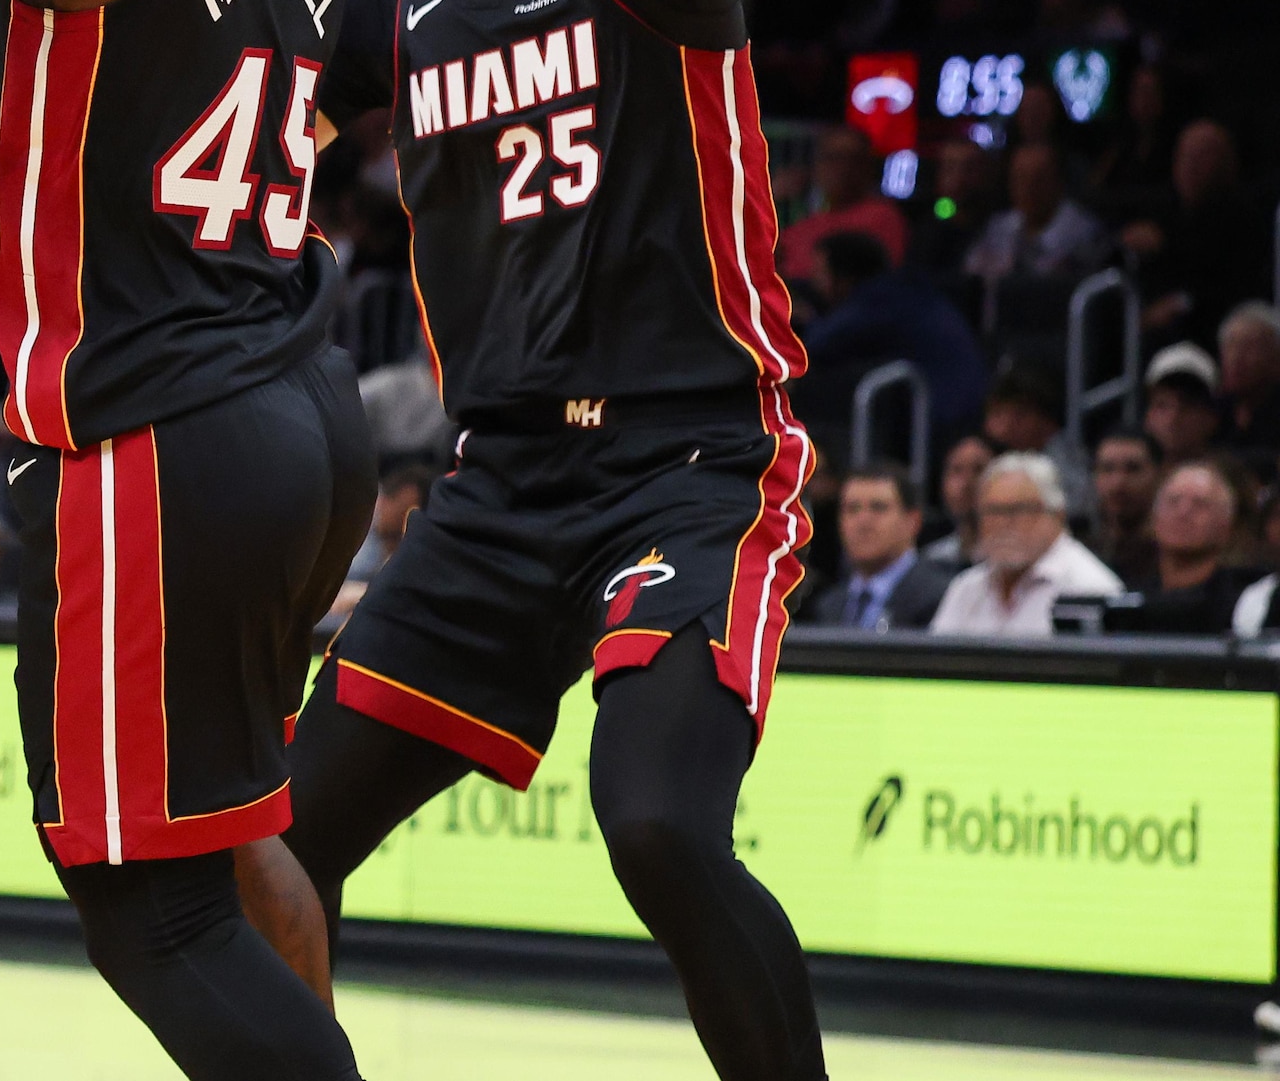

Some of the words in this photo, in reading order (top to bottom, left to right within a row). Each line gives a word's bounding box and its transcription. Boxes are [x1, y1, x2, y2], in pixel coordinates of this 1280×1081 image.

[407, 18, 600, 139] MIAMI
[153, 47, 323, 259] 45
[494, 104, 601, 225] 25
[922, 788, 1203, 867] Robinhood
